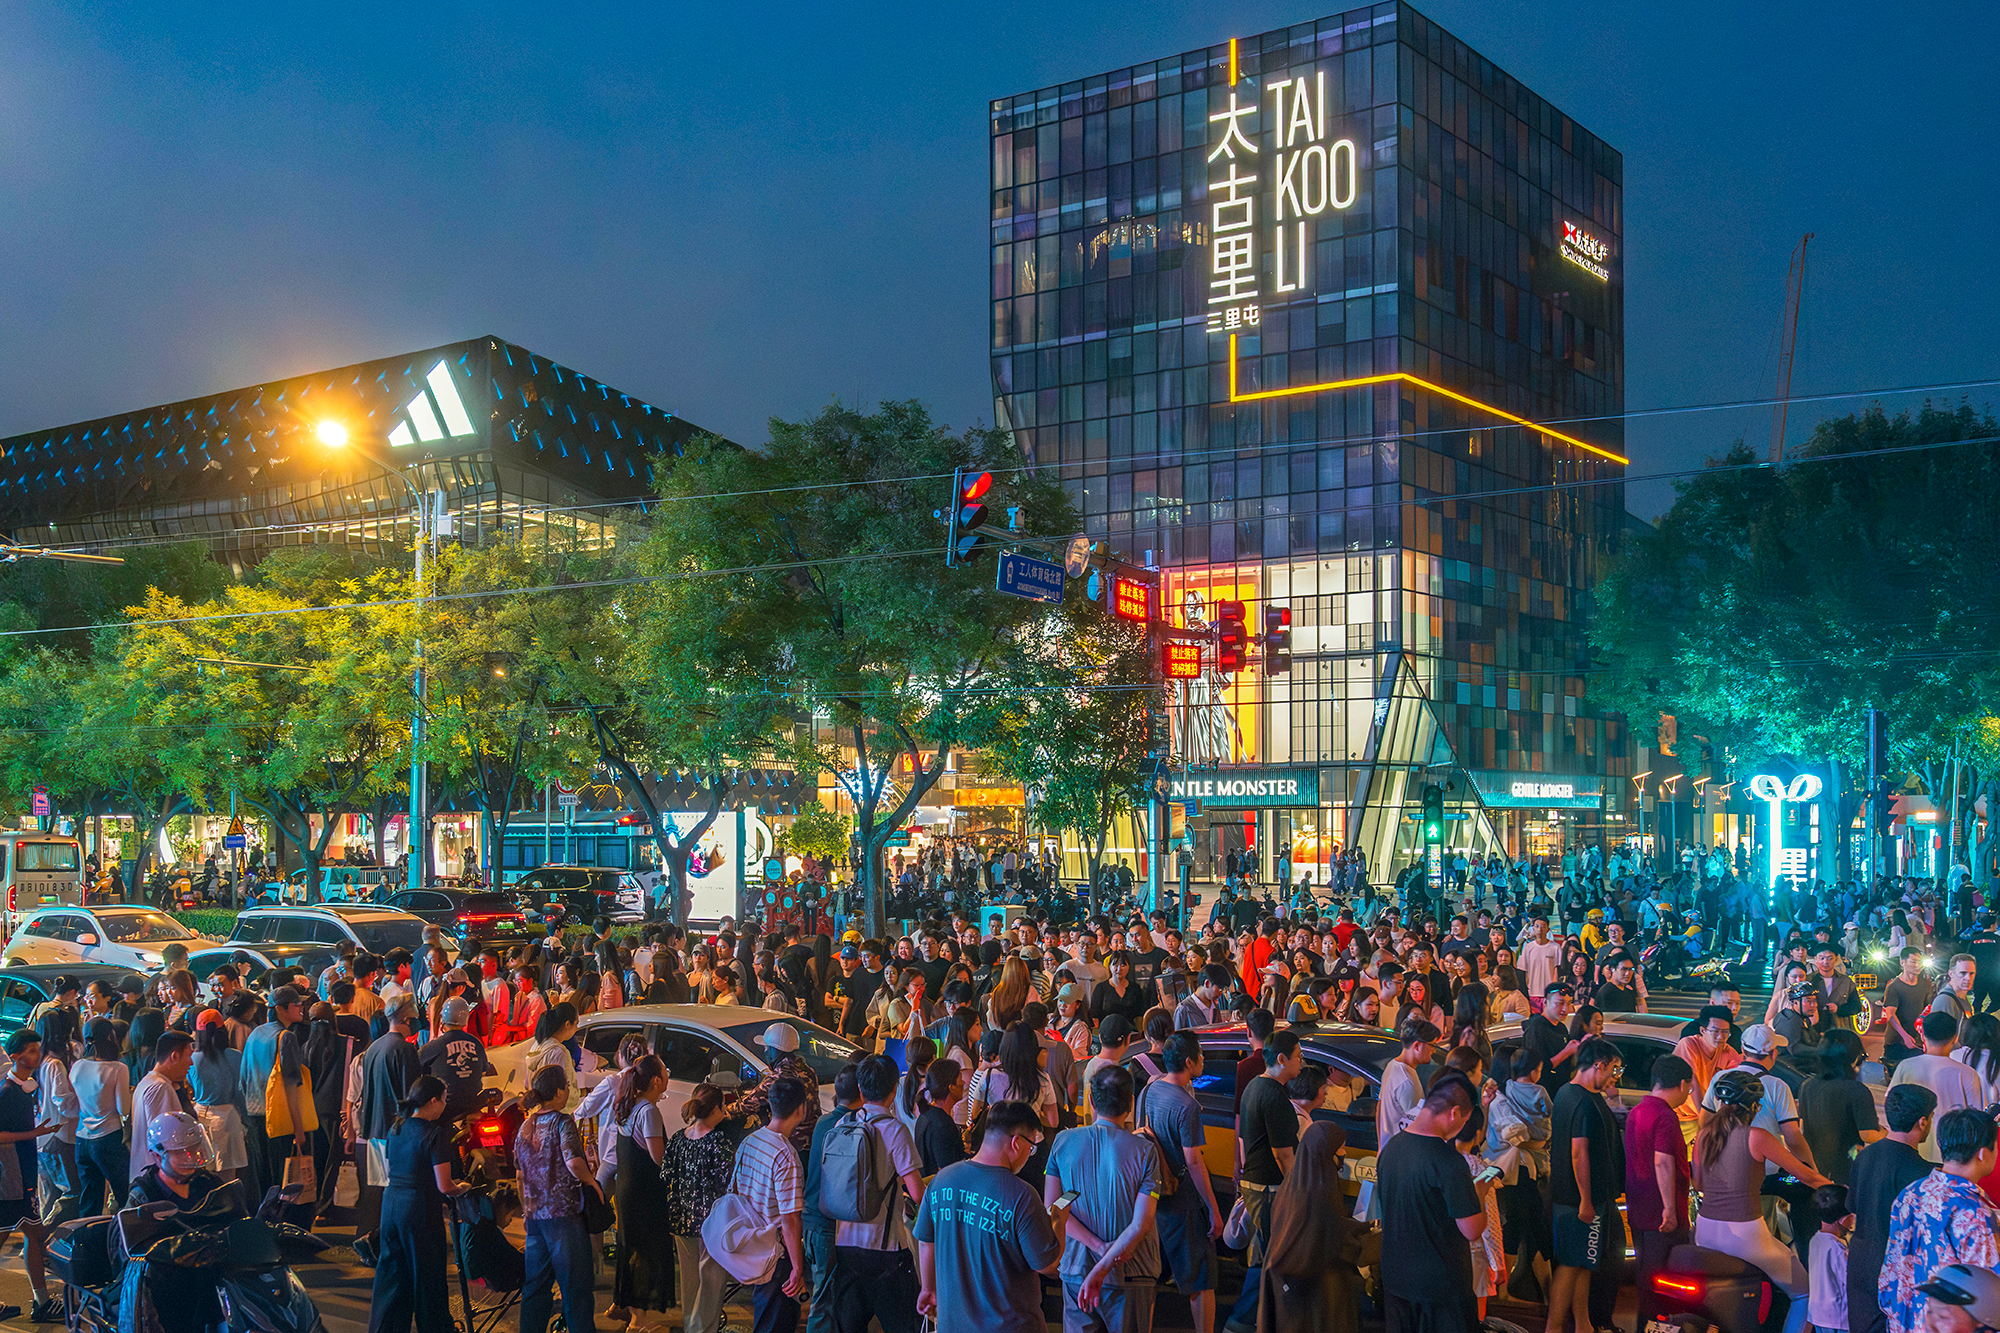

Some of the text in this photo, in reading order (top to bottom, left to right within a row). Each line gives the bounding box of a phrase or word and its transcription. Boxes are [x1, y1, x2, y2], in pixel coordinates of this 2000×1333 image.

[1267, 71, 1324, 148] TAI
[1276, 139, 1356, 221] KOO
[1207, 92, 1259, 304] 太古里
[1276, 221, 1306, 293] LI
[1206, 304, 1260, 333] 三里屯
[1019, 562, 1061, 585] 工人体育场北路
[1120, 583, 1145, 602] 禁止落客
[1171, 647, 1198, 660] 禁止落客
[1170, 780, 1298, 797] NTLE MONSTER
[1512, 782, 1573, 798] GENTLE MONSTER
[446, 1040, 477, 1057] NIKE
[1358, 1166, 1378, 1178] TA
[942, 1187, 953, 1201] TO
[959, 1189, 979, 1206] THE
[981, 1196, 1013, 1222] IZZ-O
[939, 1208, 951, 1221] TO
[956, 1209, 976, 1226] THE
[1587, 1215, 1601, 1264] JORDAN
